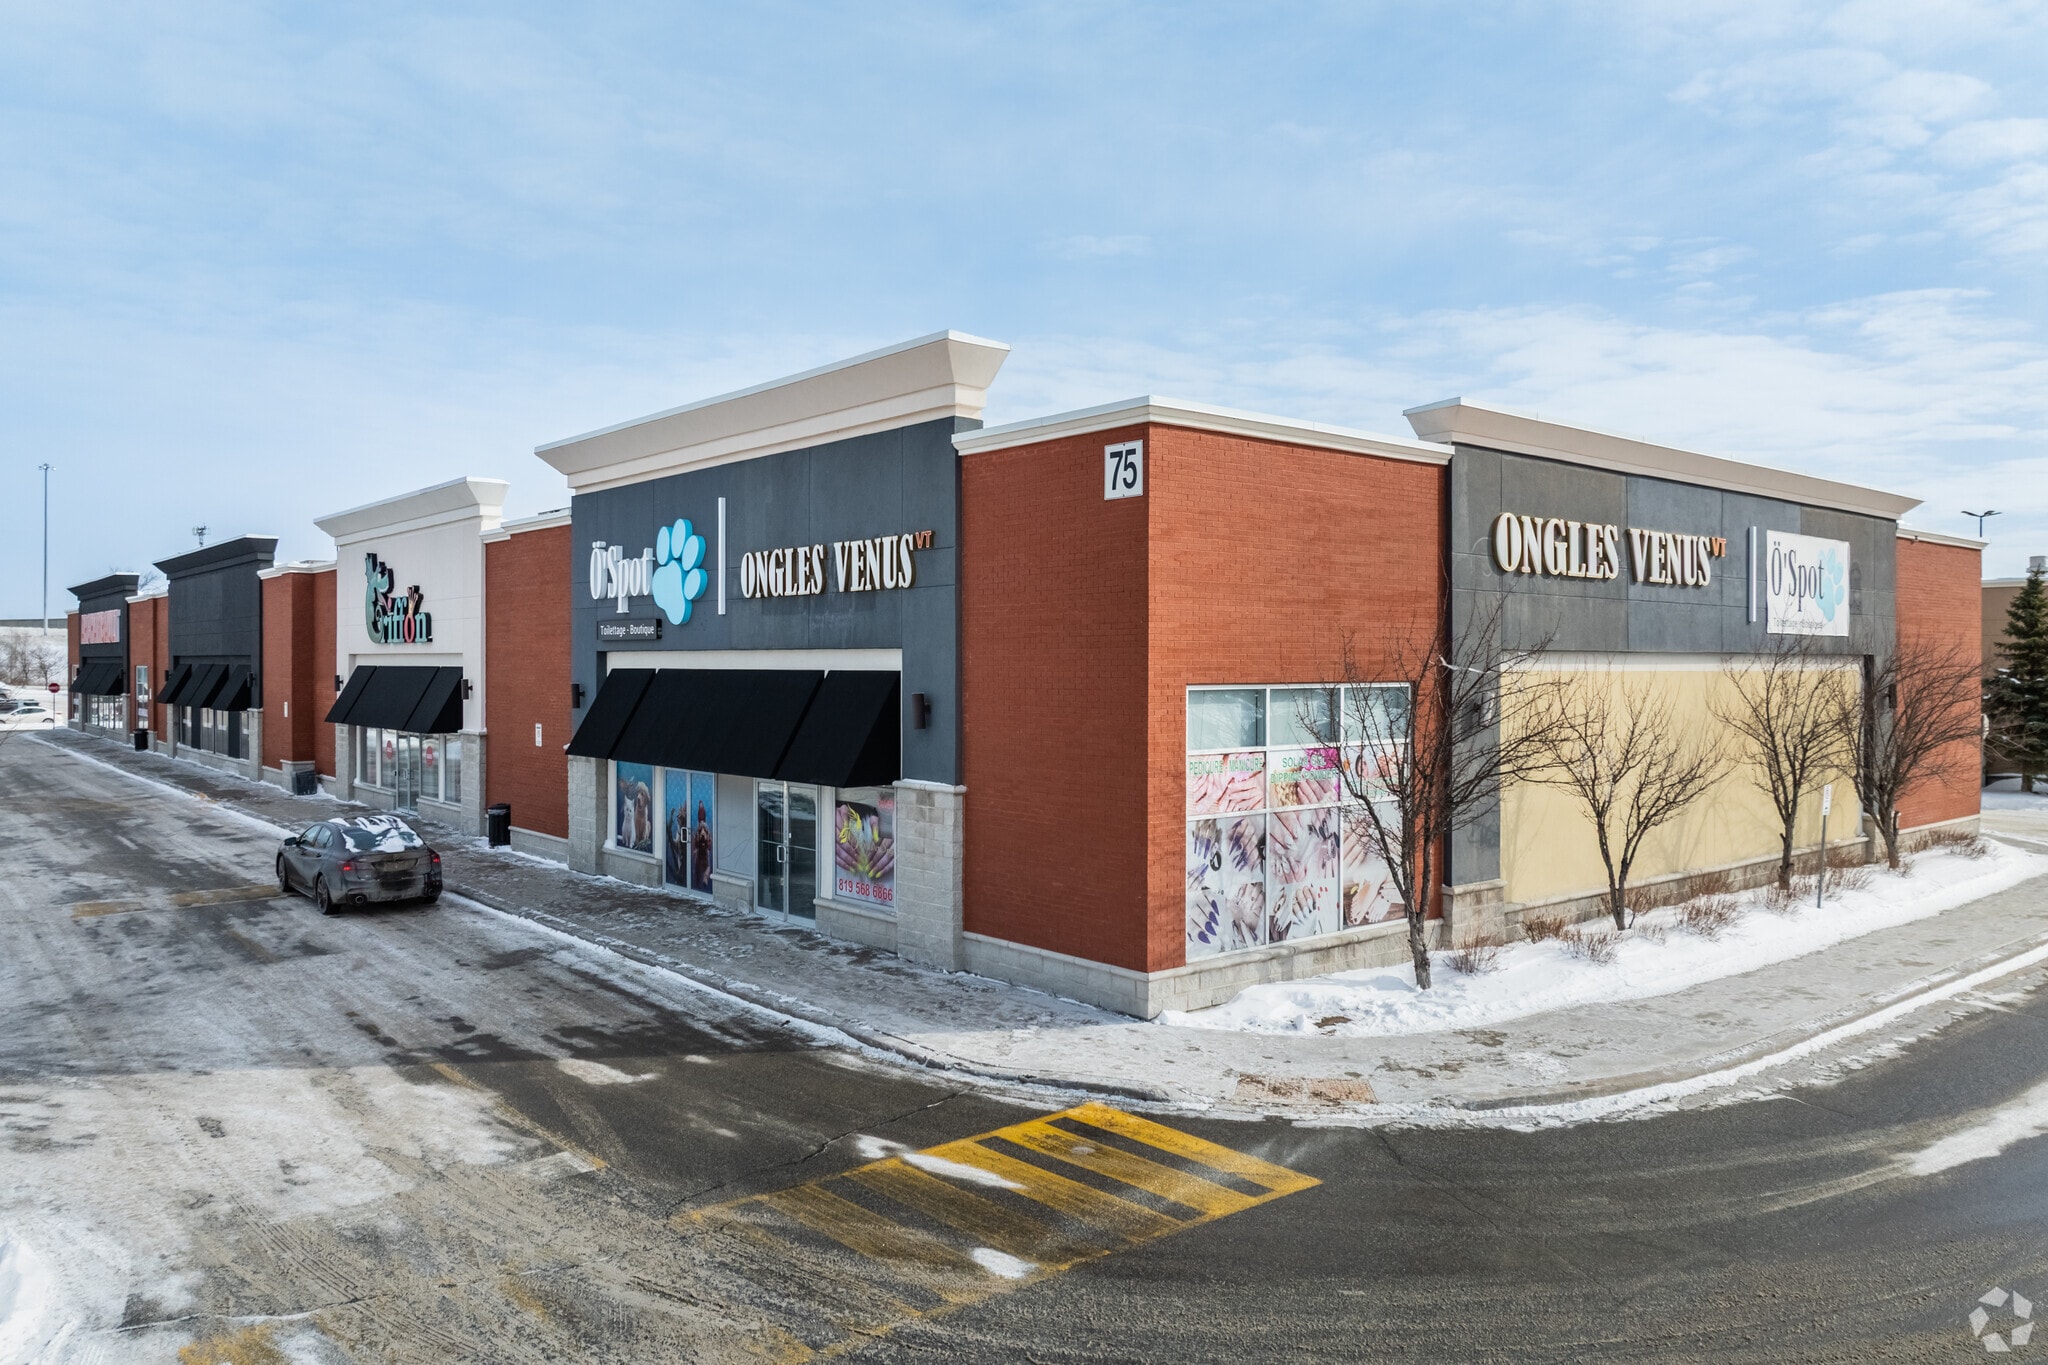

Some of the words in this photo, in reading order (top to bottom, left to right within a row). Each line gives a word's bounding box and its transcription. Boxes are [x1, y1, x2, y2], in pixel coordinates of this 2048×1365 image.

[1110, 448, 1137, 490] 75
[740, 544, 826, 599] ONGLES
[834, 533, 914, 592] VENUS
[915, 530, 933, 549] VT
[1496, 512, 1619, 580] ONGLES
[1628, 528, 1711, 586] VENUS
[1711, 537, 1727, 557] VT
[600, 624, 626, 637] Toilettage
[630, 624, 654, 636] Boutique
[1190, 760, 1223, 775] PEDICURE
[1229, 757, 1263, 772] MANICURE
[839, 878, 853, 893] 819
[855, 882, 870, 897] 568
[872, 885, 893, 902] 6866
